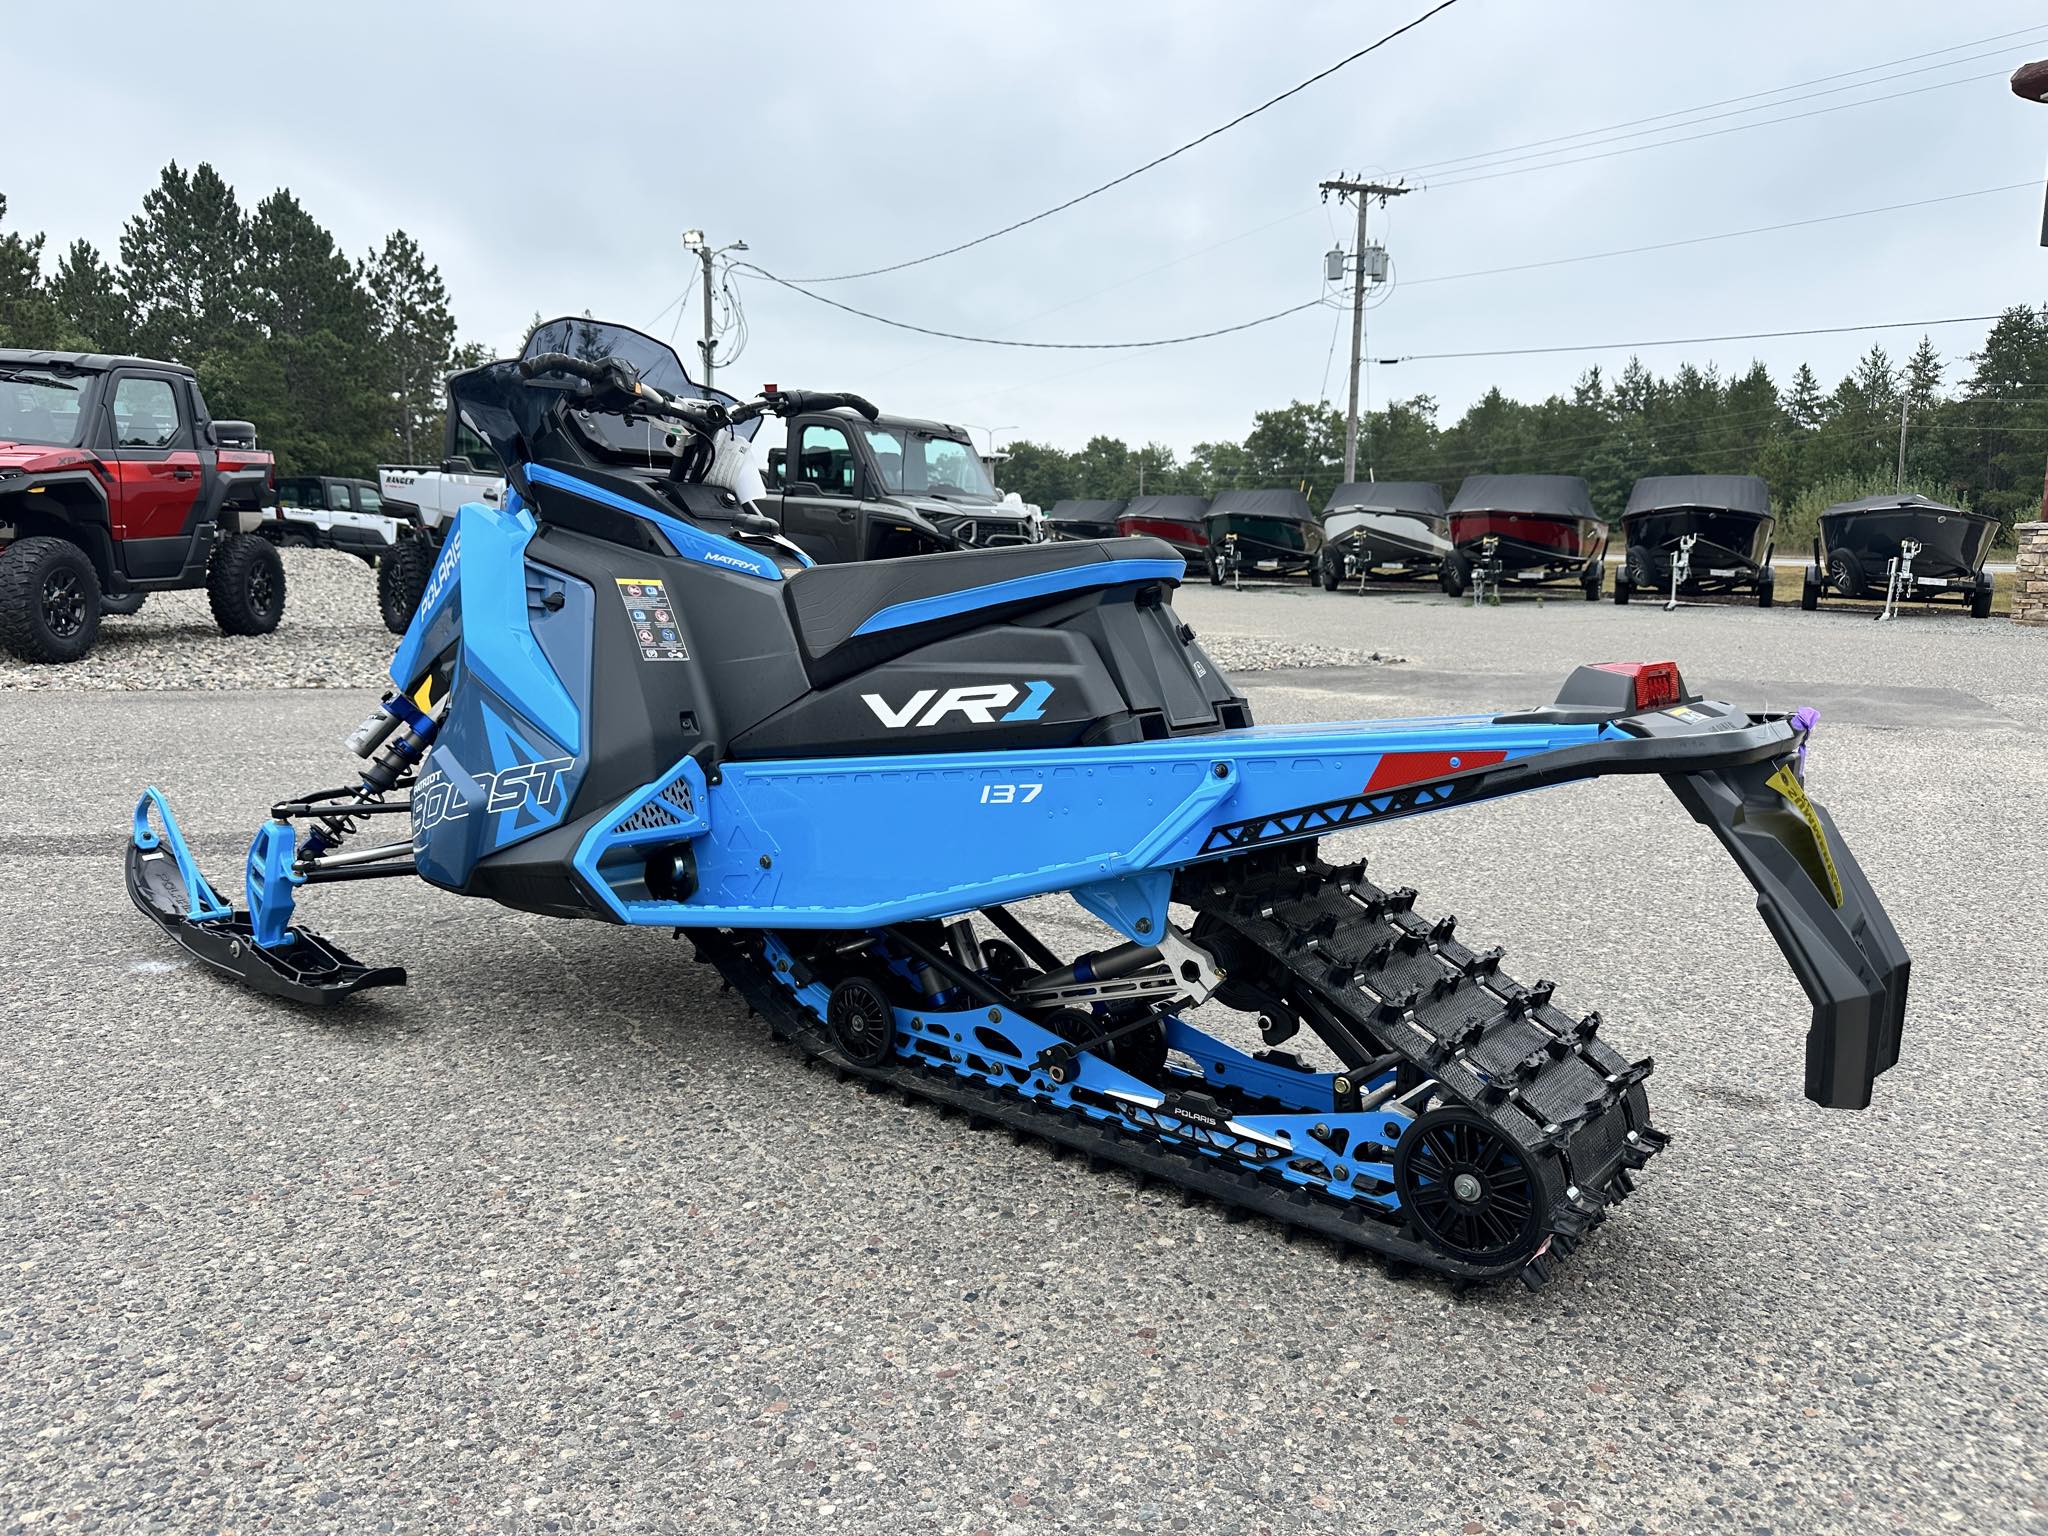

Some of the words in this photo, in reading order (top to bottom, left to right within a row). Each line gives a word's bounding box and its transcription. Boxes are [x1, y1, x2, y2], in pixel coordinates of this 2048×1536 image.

[385, 475, 416, 486] RANGER
[704, 551, 761, 575] MATRYX
[860, 680, 1055, 728] VR1
[413, 769, 443, 796] PATRIOT
[980, 783, 1044, 804] 137
[1174, 1107, 1217, 1126] POLARIS
